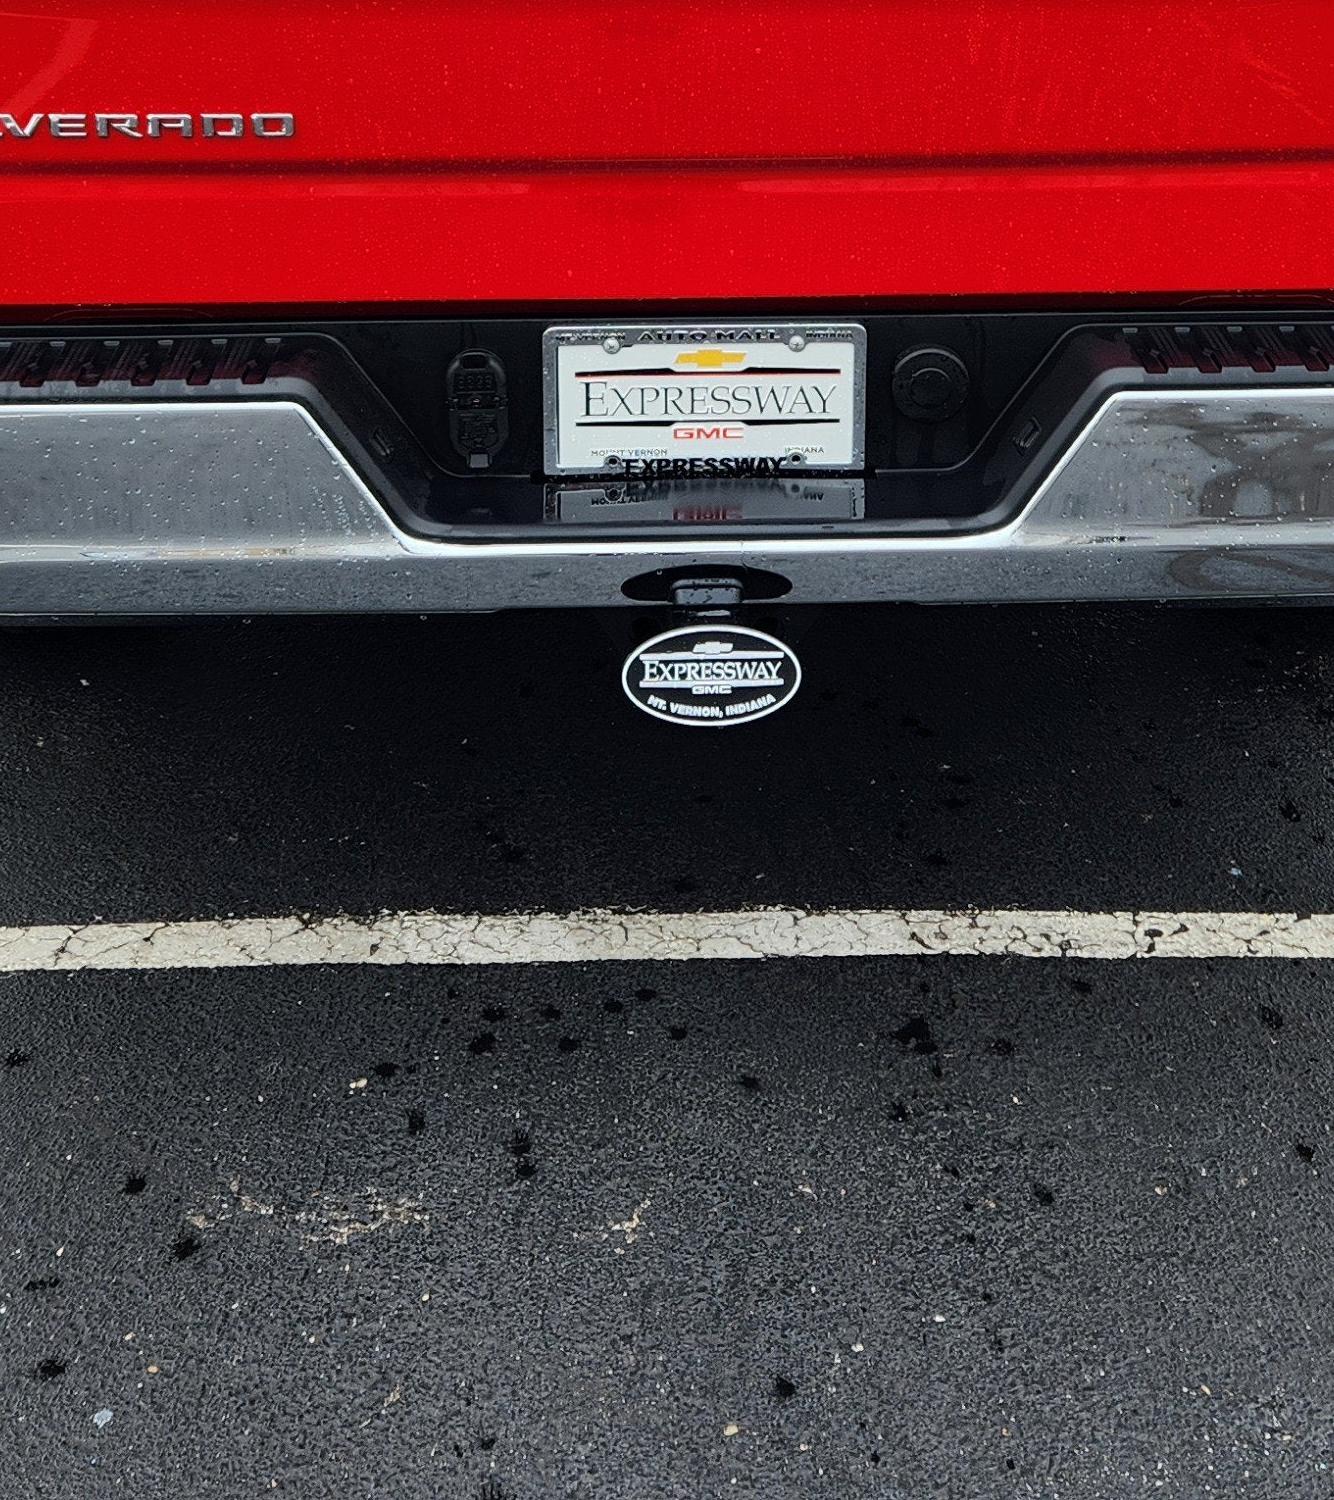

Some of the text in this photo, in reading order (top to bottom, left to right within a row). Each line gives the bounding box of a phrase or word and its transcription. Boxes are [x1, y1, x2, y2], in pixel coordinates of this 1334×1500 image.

[637, 328, 782, 342] AUTO MALL
[805, 329, 855, 339] INDIANA
[673, 426, 745, 440] GMC
[627, 448, 668, 457] VERNON
[622, 456, 787, 478] EXPRESSWAY
[691, 684, 733, 695] GMC
[647, 693, 777, 718] MT. VERNON, INDIANA
